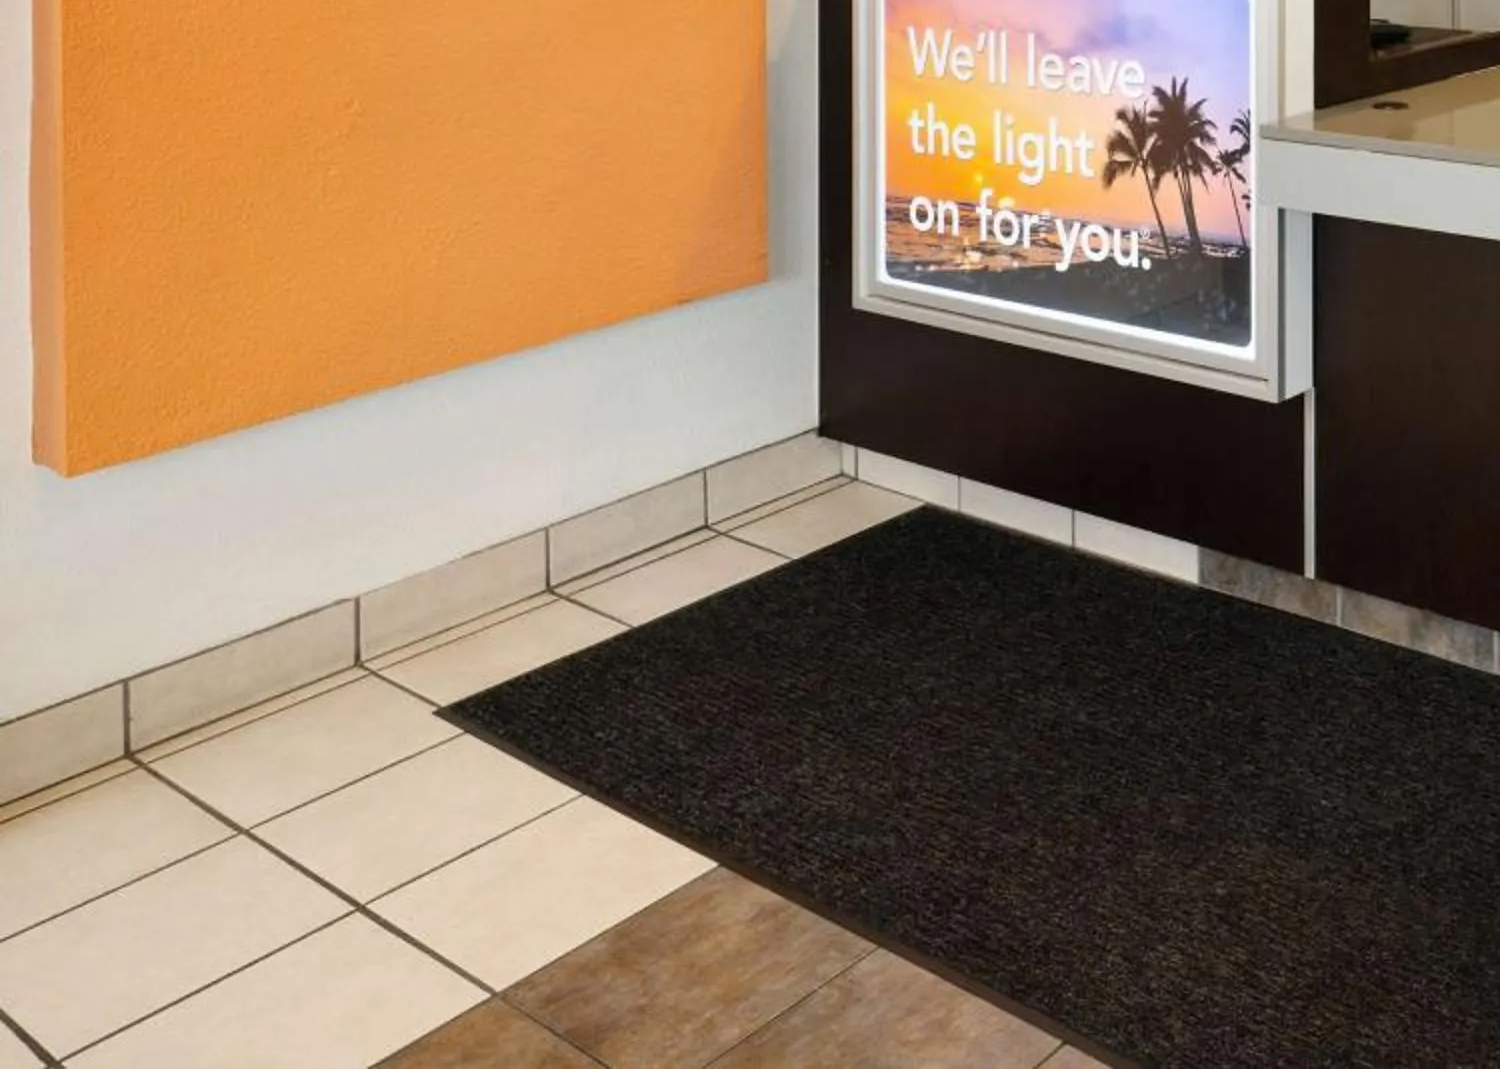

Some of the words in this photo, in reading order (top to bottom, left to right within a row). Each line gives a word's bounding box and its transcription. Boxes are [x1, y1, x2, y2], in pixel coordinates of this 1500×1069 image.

[907, 26, 1008, 84] We'll
[1026, 32, 1146, 98] leave
[907, 102, 976, 161] the
[992, 109, 1095, 185] light
[909, 194, 960, 237] on
[975, 187, 1040, 250] for
[1055, 217, 1152, 273] you.
